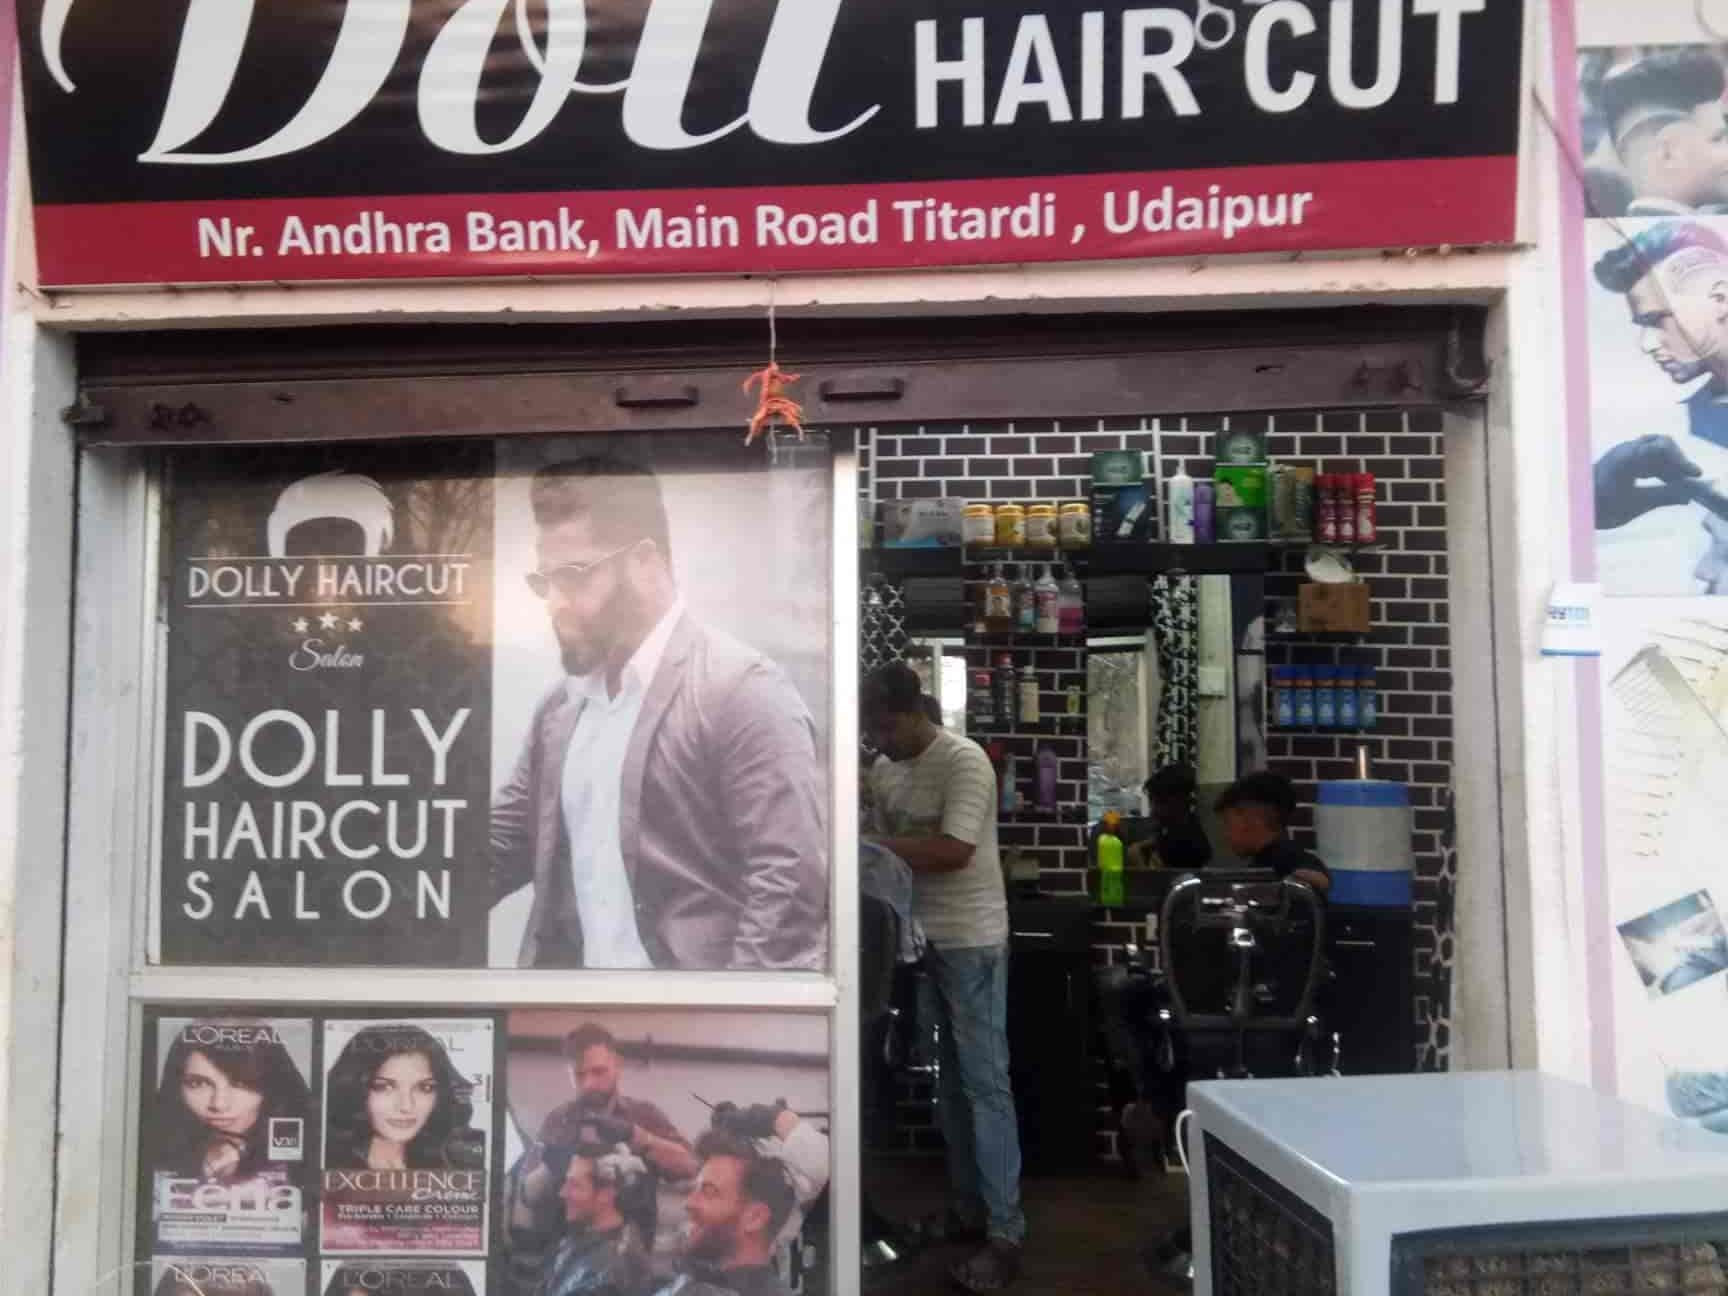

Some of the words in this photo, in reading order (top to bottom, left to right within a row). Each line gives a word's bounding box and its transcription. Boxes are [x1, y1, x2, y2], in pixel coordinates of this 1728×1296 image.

[915, 8, 1200, 129] HAIR
[1244, 0, 1486, 113] CUT
[197, 216, 263, 259] Nr.
[277, 210, 452, 257] Andhra
[466, 206, 600, 260] Bank,
[615, 204, 740, 250] Main
[756, 198, 878, 247] Road
[893, 191, 1056, 243] Titardi
[1103, 184, 1315, 240] Udaipur
[188, 564, 305, 598] DOLLY
[316, 562, 471, 597] HAIRCUT
[288, 638, 365, 672] Salon
[182, 707, 472, 788] DOLLY
[182, 799, 469, 861] HAIRCUT
[182, 869, 452, 921] SALON
